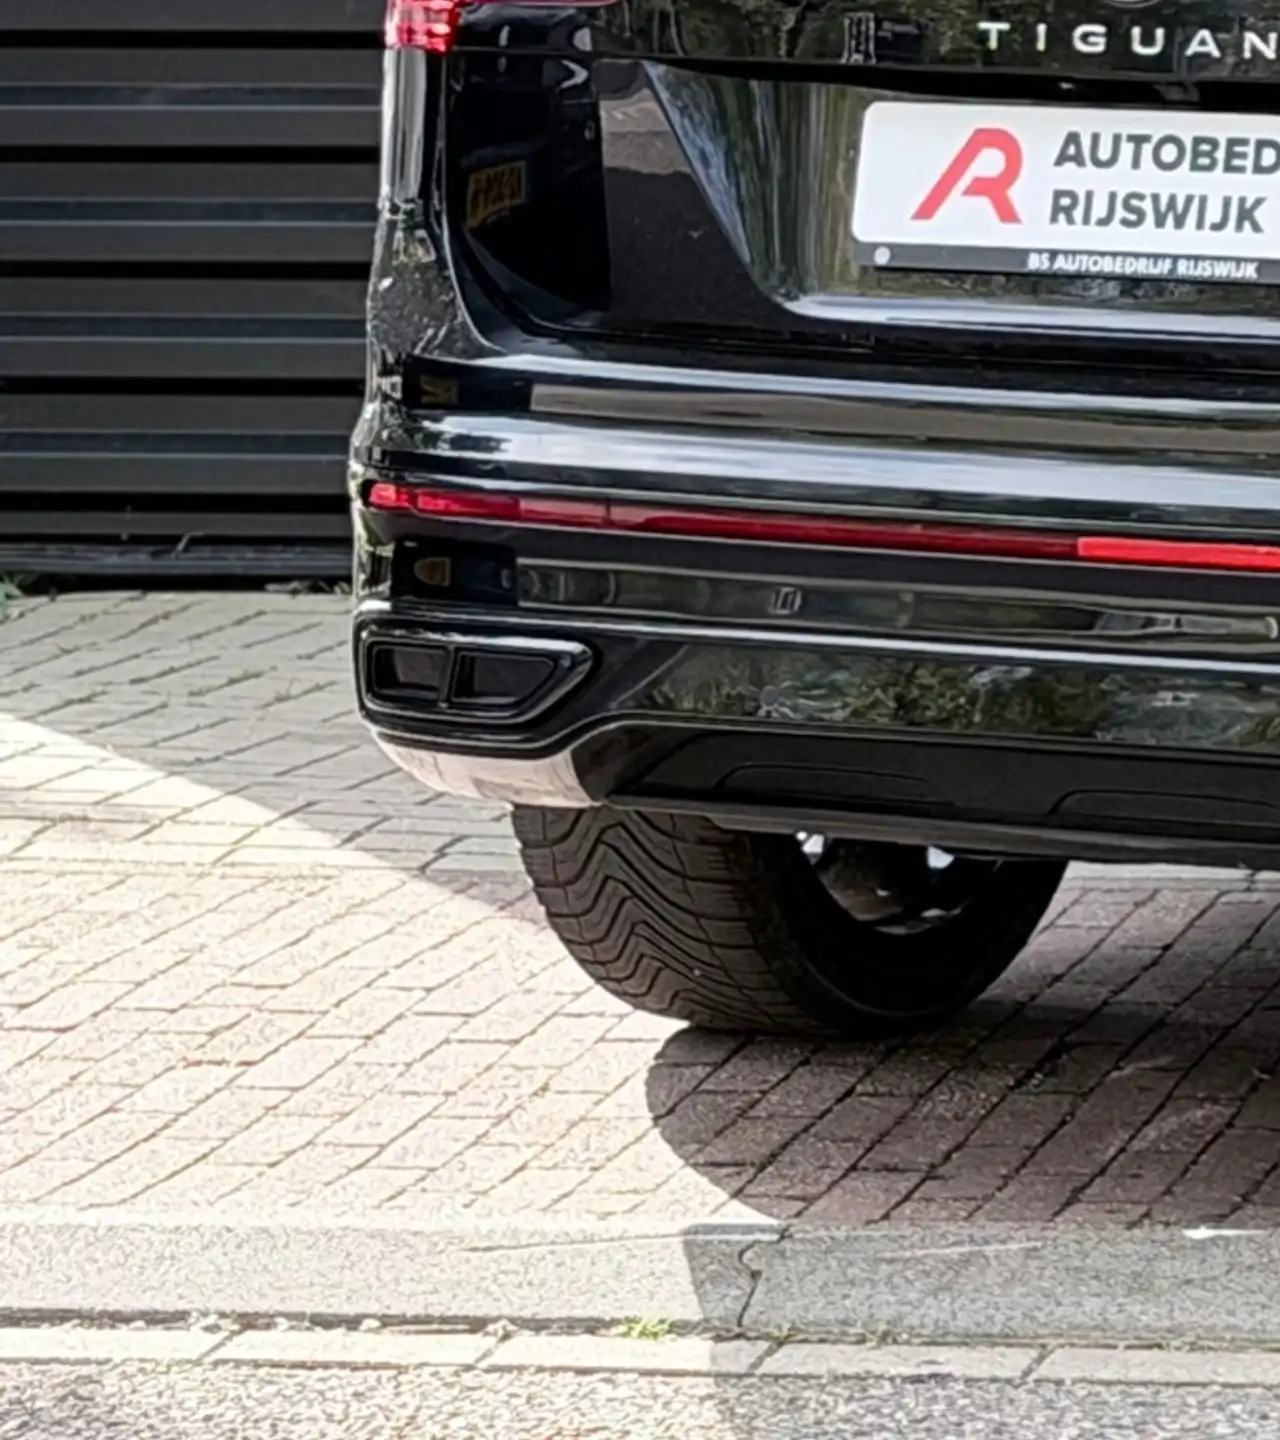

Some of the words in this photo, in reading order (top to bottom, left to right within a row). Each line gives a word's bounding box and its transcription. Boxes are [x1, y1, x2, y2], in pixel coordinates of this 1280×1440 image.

[976, 21, 1279, 60] TIGUAN
[1049, 188, 1268, 234] RIJSWIJK
[1027, 252, 1050, 271] BS
[1052, 254, 1173, 277] AUTOBEDRIJF
[1175, 258, 1260, 280] RIJSWIJK
